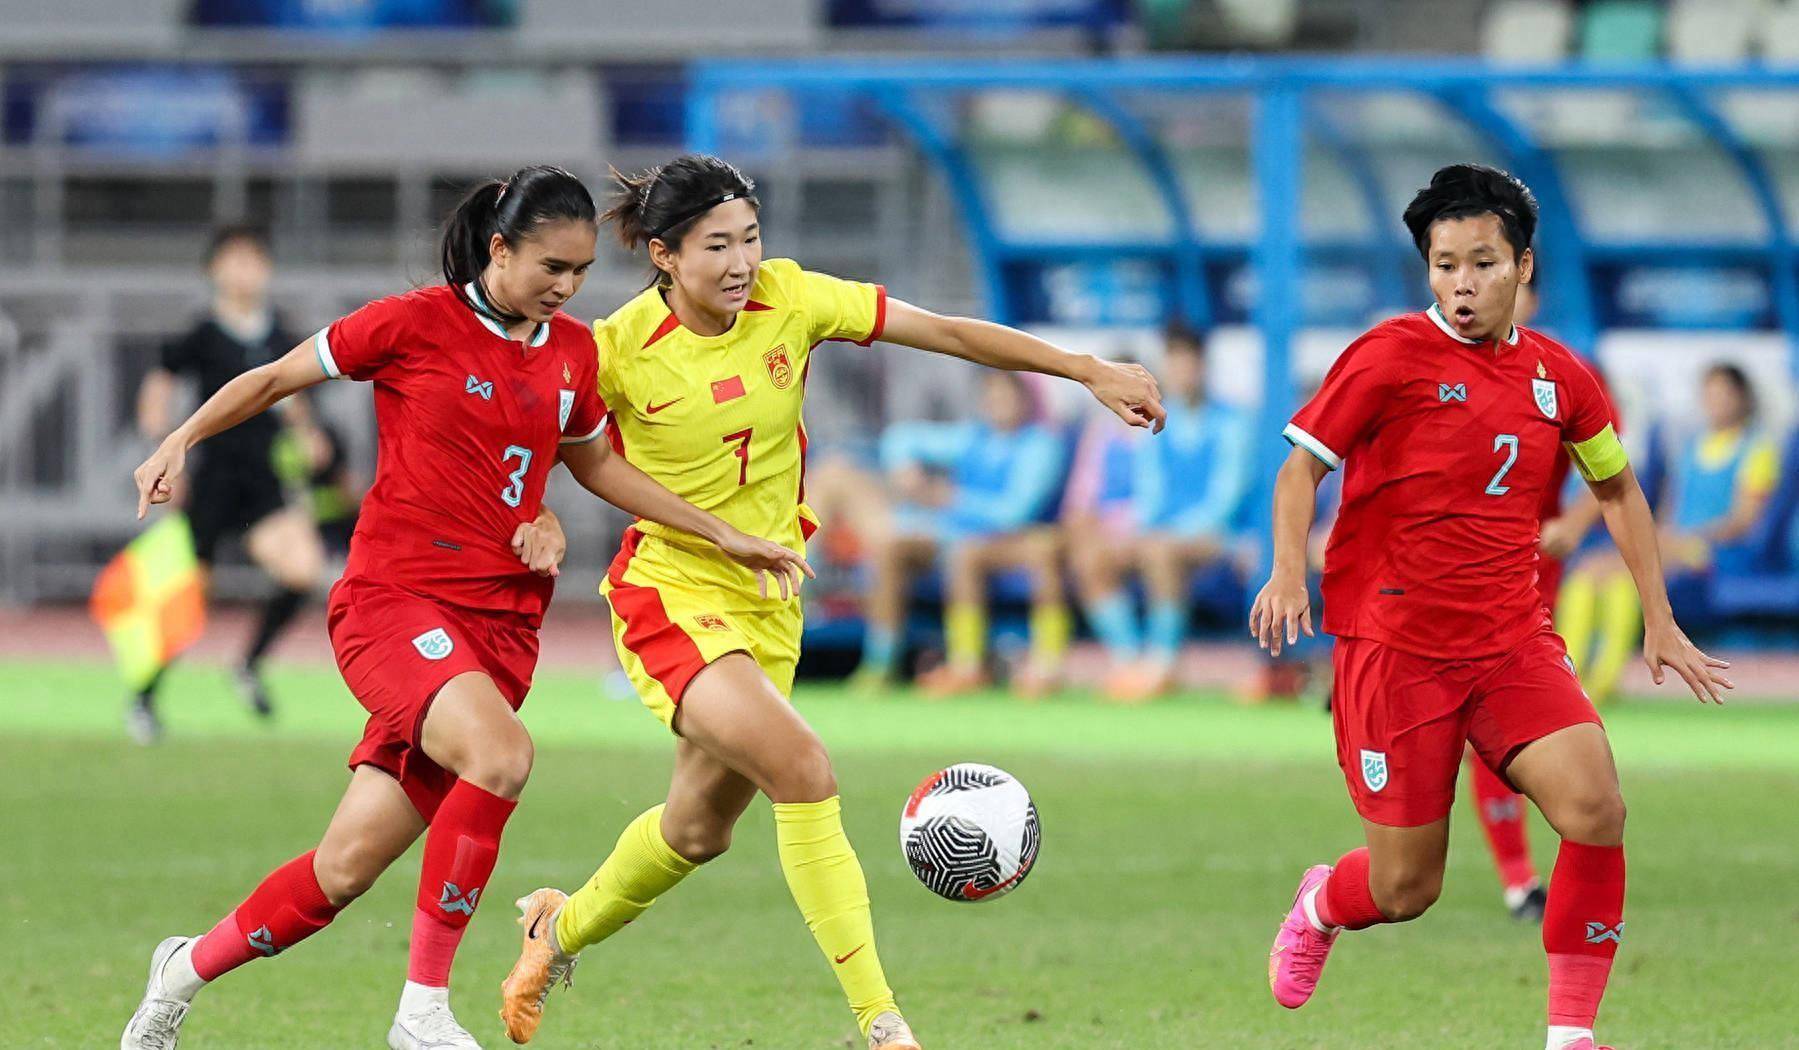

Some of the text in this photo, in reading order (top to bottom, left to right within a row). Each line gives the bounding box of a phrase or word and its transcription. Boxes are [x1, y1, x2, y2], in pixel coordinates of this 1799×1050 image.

[501, 445, 532, 507] 3
[722, 427, 753, 486] 7
[1485, 434, 1519, 495] 2
